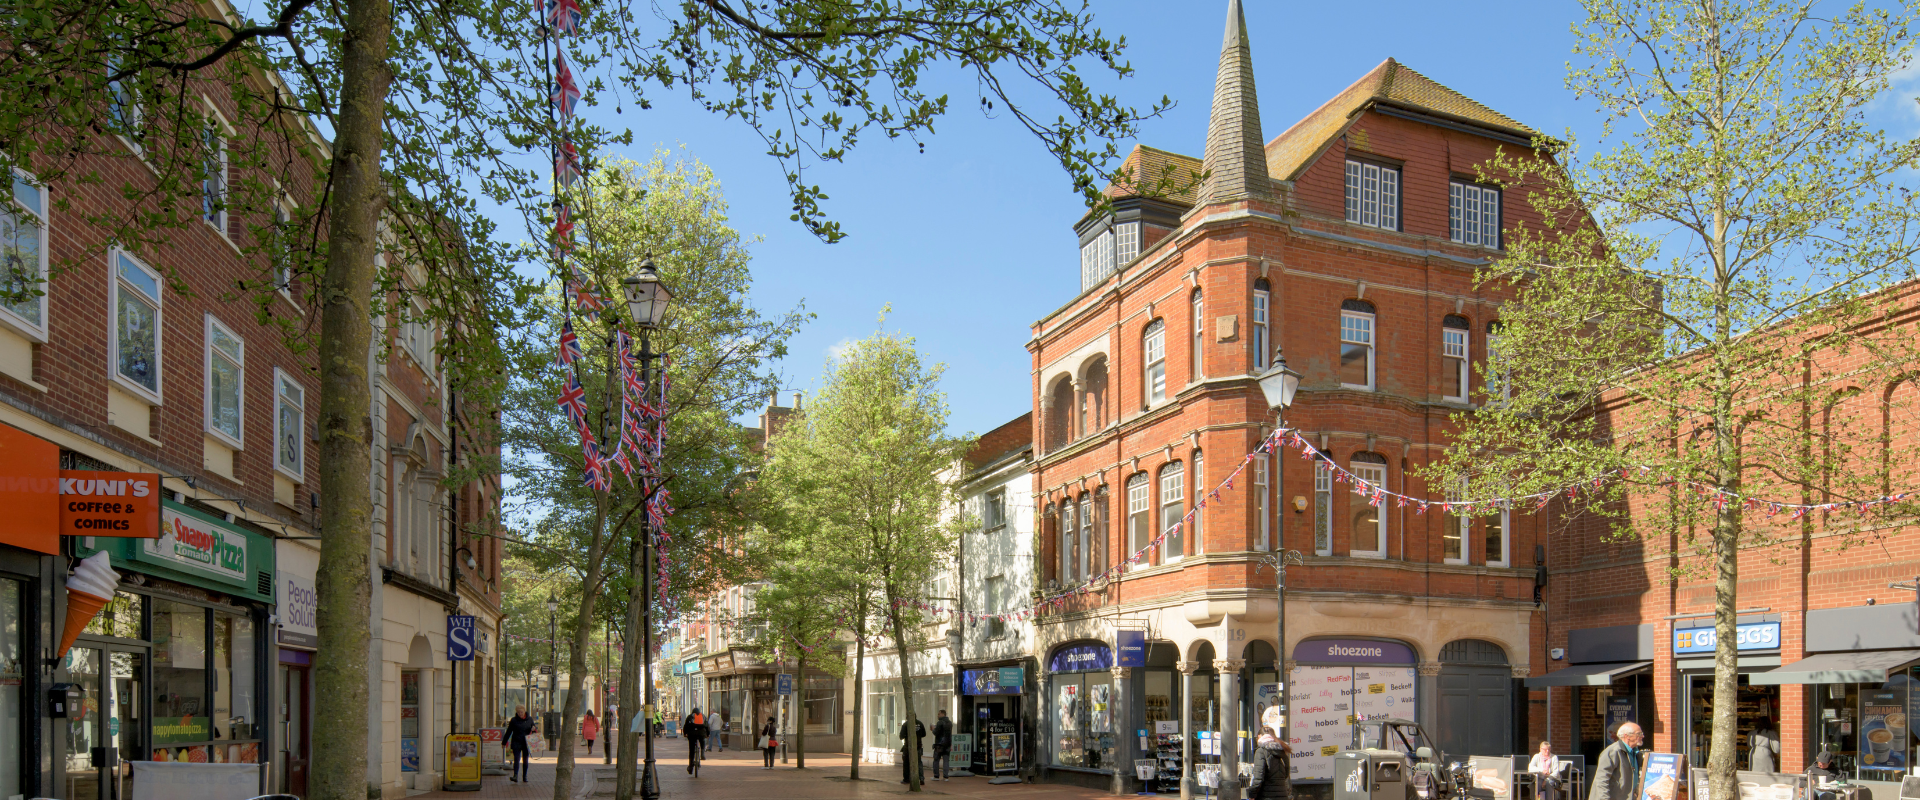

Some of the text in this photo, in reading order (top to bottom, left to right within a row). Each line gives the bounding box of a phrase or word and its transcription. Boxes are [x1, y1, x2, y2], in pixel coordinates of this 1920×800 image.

[126, 300, 140, 340] P
[287, 433, 296, 463] S
[59, 478, 150, 497] KUNI'S
[125, 504, 135, 514] &
[174, 517, 245, 573] Snappy Pizza
[175, 544, 210, 562] Tomato
[288, 602, 317, 629] Soluti
[450, 618, 472, 627] WH
[1213, 629, 1226, 641] 19
[1228, 628, 1246, 641] 19
[1695, 626, 1773, 647] GRGGS
[449, 626, 472, 658] S
[1328, 644, 1382, 657] shoezone
[1067, 652, 1096, 663] shoezone
[1327, 675, 1352, 683] RedFish
[1390, 682, 1413, 691] Beckett
[1301, 706, 1326, 715] RedFish
[1609, 704, 1632, 712] EVERYDAY
[1864, 706, 1903, 715] CINNAMON
[1367, 712, 1390, 721] Beckett
[1315, 718, 1340, 728] hobos
[482, 730, 490, 740] 3
